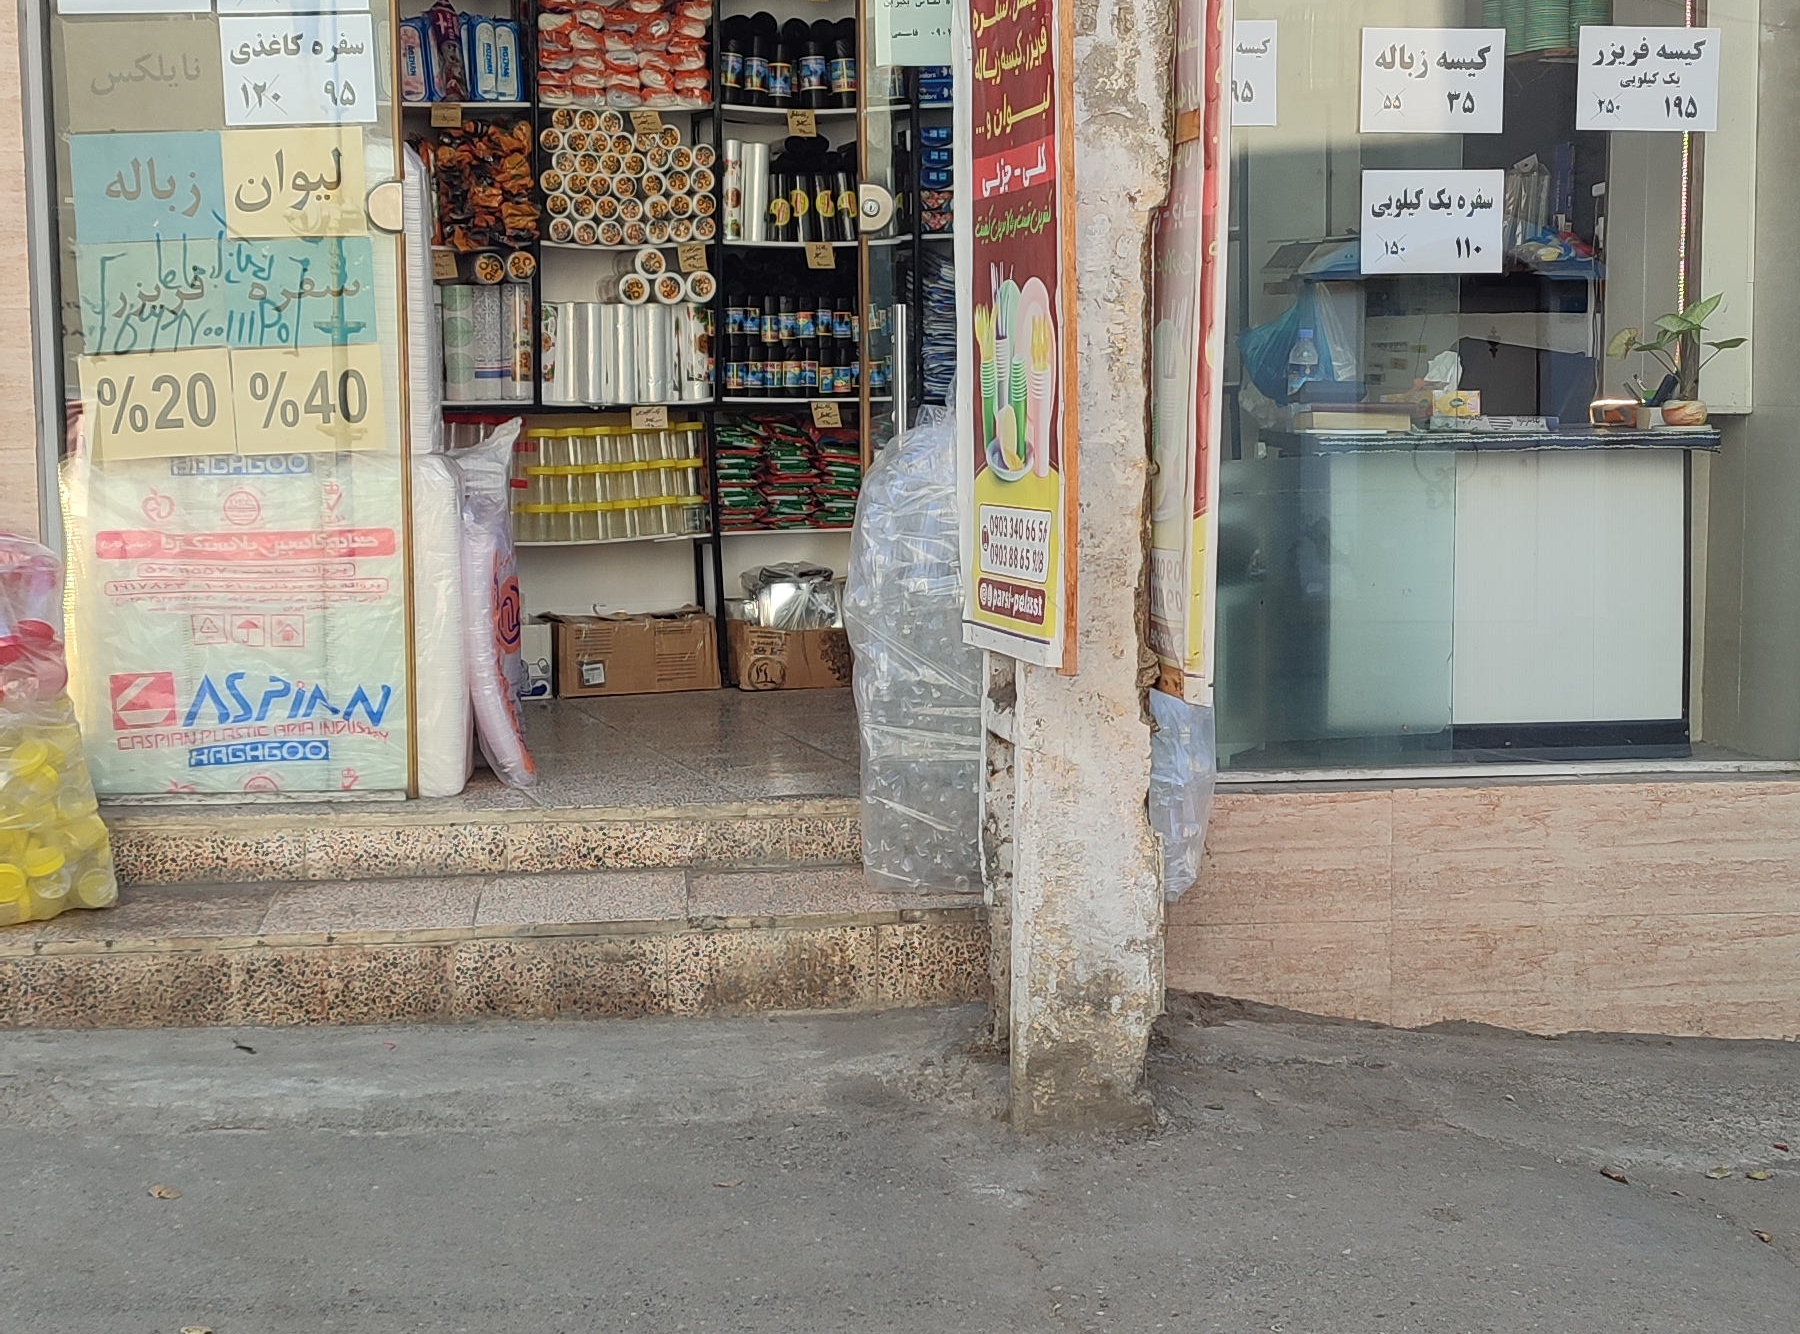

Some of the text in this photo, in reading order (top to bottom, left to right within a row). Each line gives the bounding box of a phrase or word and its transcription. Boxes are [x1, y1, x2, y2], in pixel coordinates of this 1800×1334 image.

[230, 32, 364, 64] سفره کاغذی
[1001, 29, 1022, 75] کیسه
[1236, 38, 1271, 58] کیسه
[1375, 44, 1491, 78] کیسه زباله
[1592, 37, 1706, 66] کیسه فریزر
[90, 53, 201, 95] نایلکس
[975, 47, 1001, 85] زباله
[1620, 71, 1680, 88] یک کیلویی
[323, 80, 356, 106] ۹۵
[994, 75, 1050, 136] لیوان
[1383, 90, 1475, 113] ۳۵ ۵۵
[1664, 95, 1697, 118] ۱۹۵
[986, 112, 992, 140] و
[234, 146, 342, 212] لیوان
[1023, 142, 1046, 187] کلی
[105, 157, 201, 217] زباله
[1371, 188, 1493, 217] سفره یک کیلویی
[1456, 237, 1482, 258] ۱۱۰
[249, 267, 361, 313] سفره
[990, 514, 1007, 537] 0903
[1010, 517, 1023, 540] 340
[1026, 519, 1036, 542] 66
[990, 543, 1007, 566] 0903
[1009, 545, 1018, 568] 88
[1020, 548, 1030, 571] 65
[117, 732, 197, 750] CASPIAN
[200, 725, 269, 745] PLASTIC
[274, 723, 315, 738] ARIA
